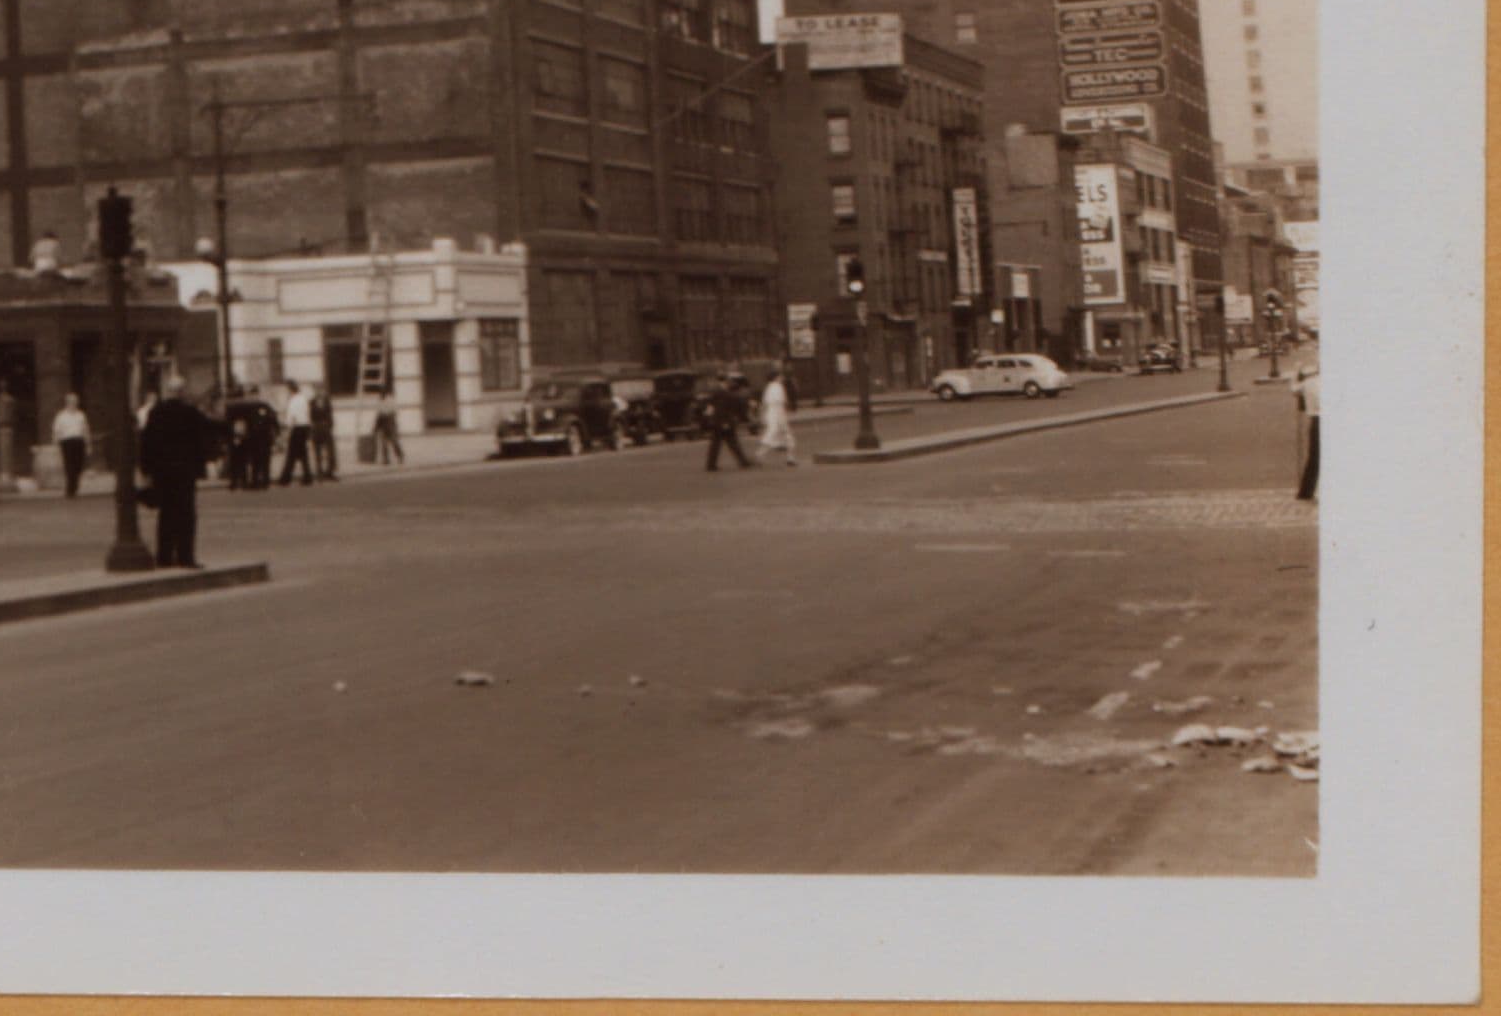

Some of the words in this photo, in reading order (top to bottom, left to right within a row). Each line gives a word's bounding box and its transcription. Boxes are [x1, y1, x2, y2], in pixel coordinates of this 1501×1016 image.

[796, 18, 819, 31] TO
[825, 15, 880, 31] LEASE
[1069, 69, 1159, 87] HOLLYWOOD
